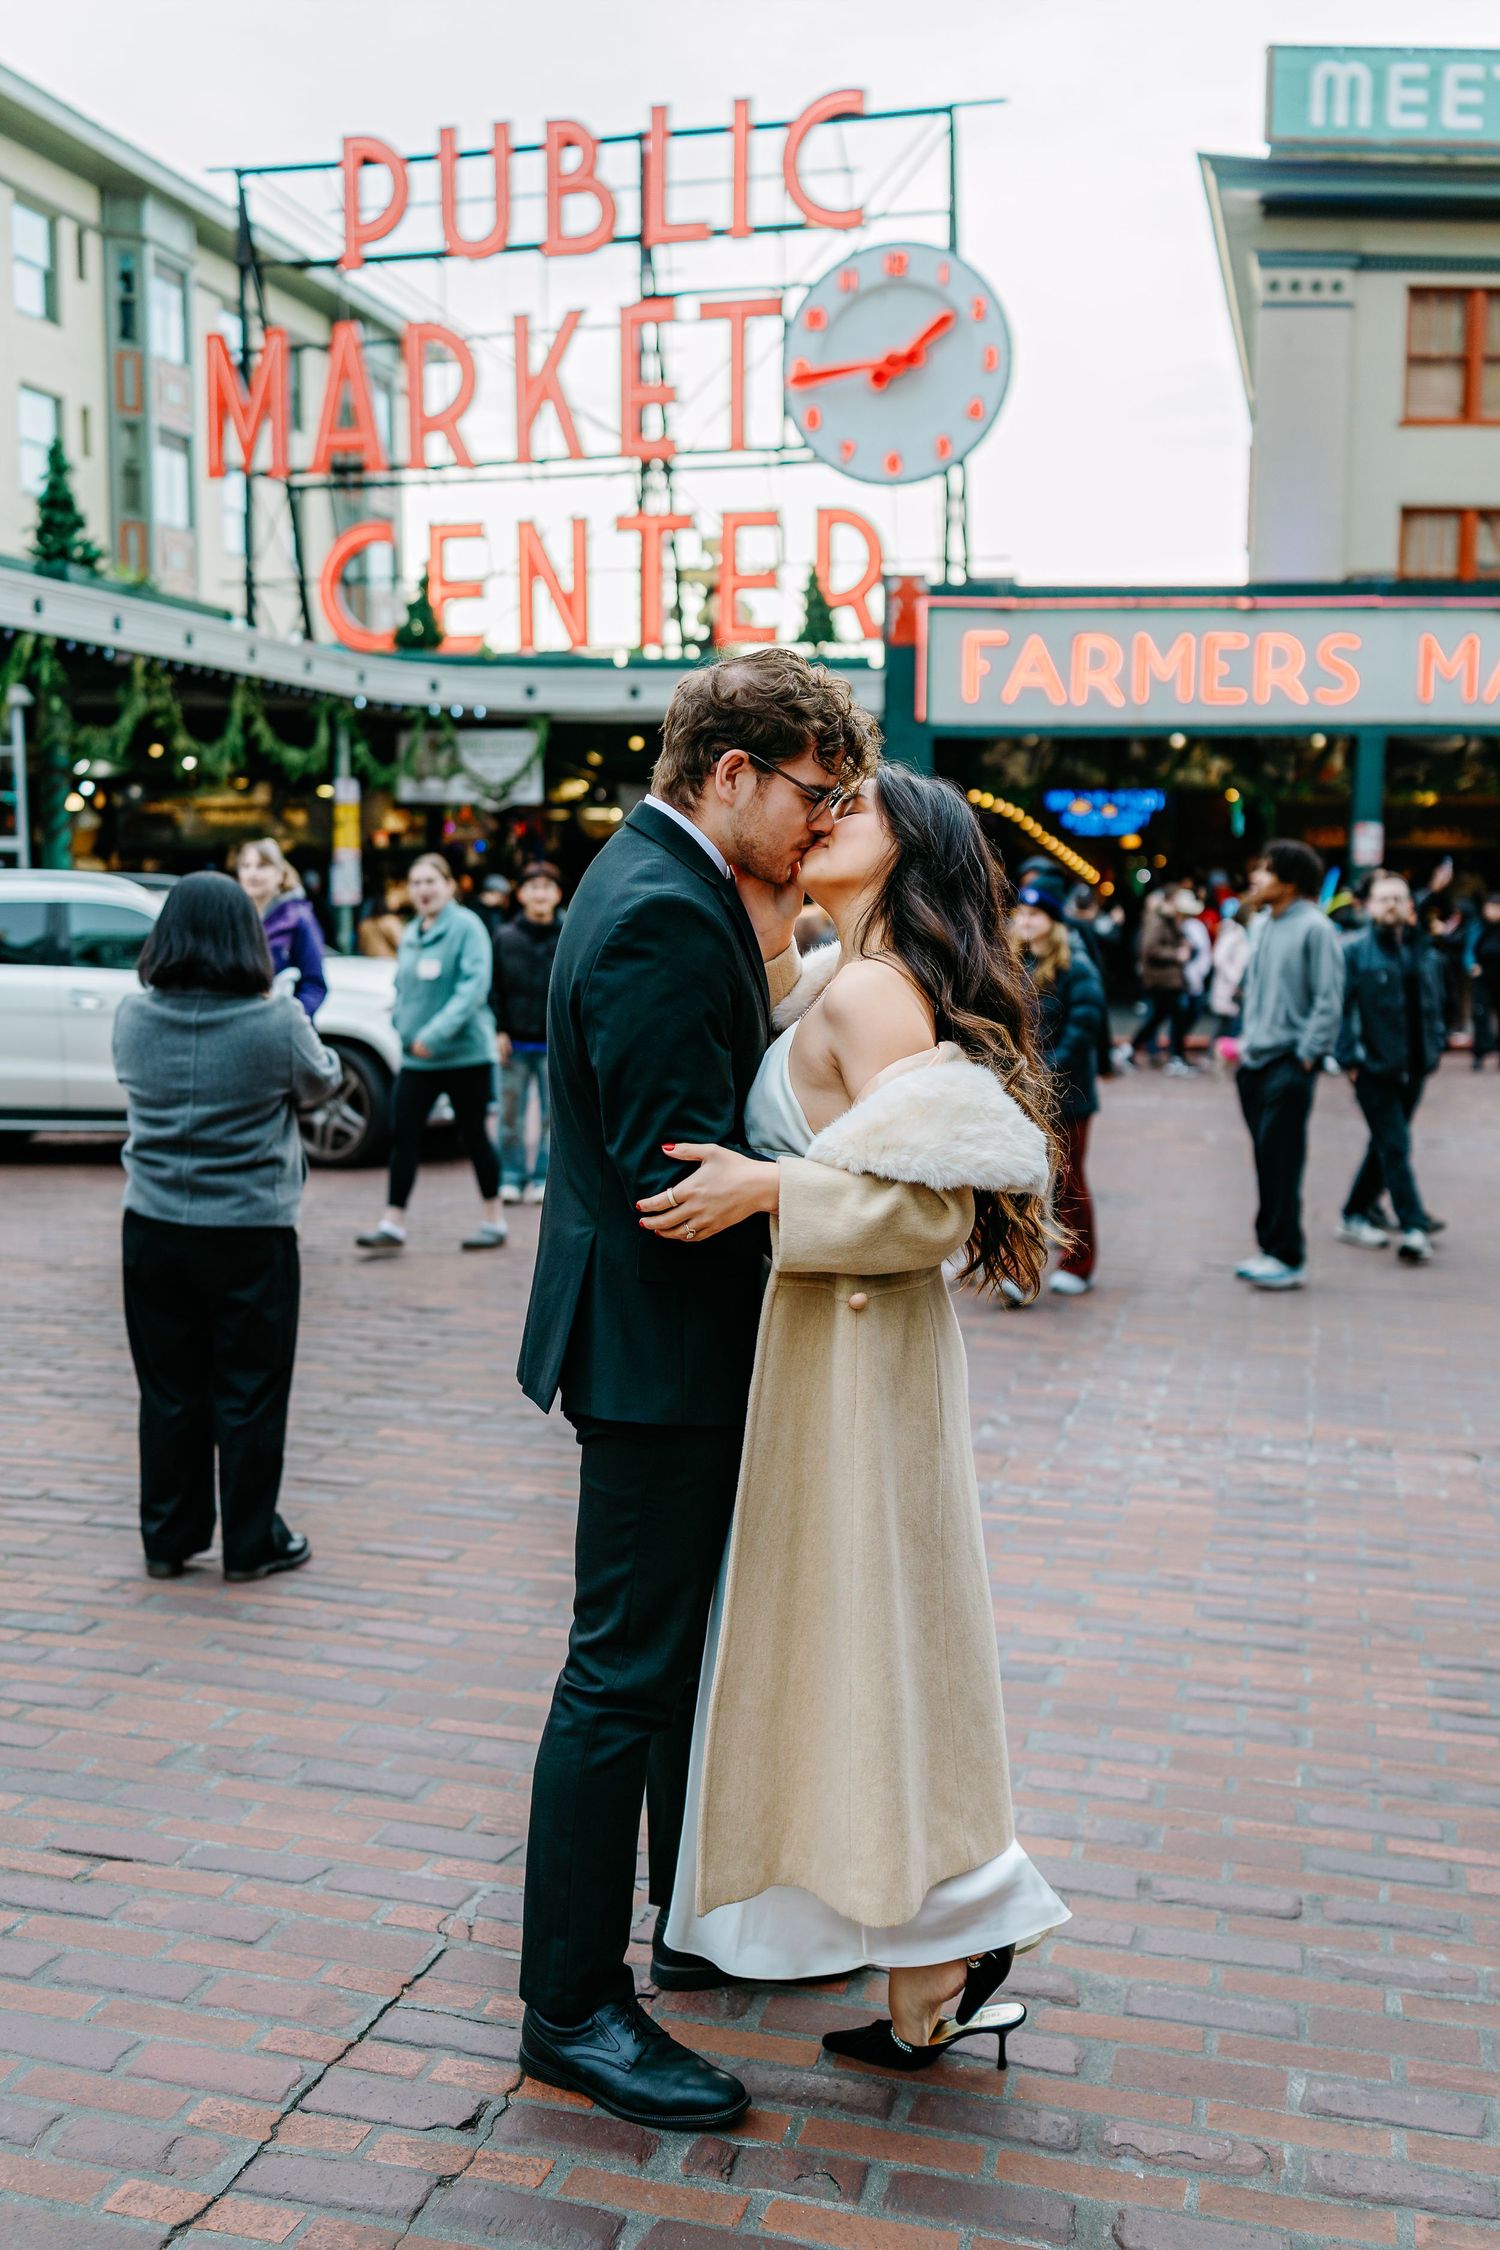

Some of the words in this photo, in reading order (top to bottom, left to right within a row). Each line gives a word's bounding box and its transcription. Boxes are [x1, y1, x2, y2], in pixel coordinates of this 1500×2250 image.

[1308, 60, 1500, 130] MEE
[340, 88, 866, 270] PUBLIC
[206, 296, 784, 479] MARKET
[320, 508, 882, 655] CENTER
[961, 629, 1362, 708] FARMERS
[1416, 631, 1500, 705] M
